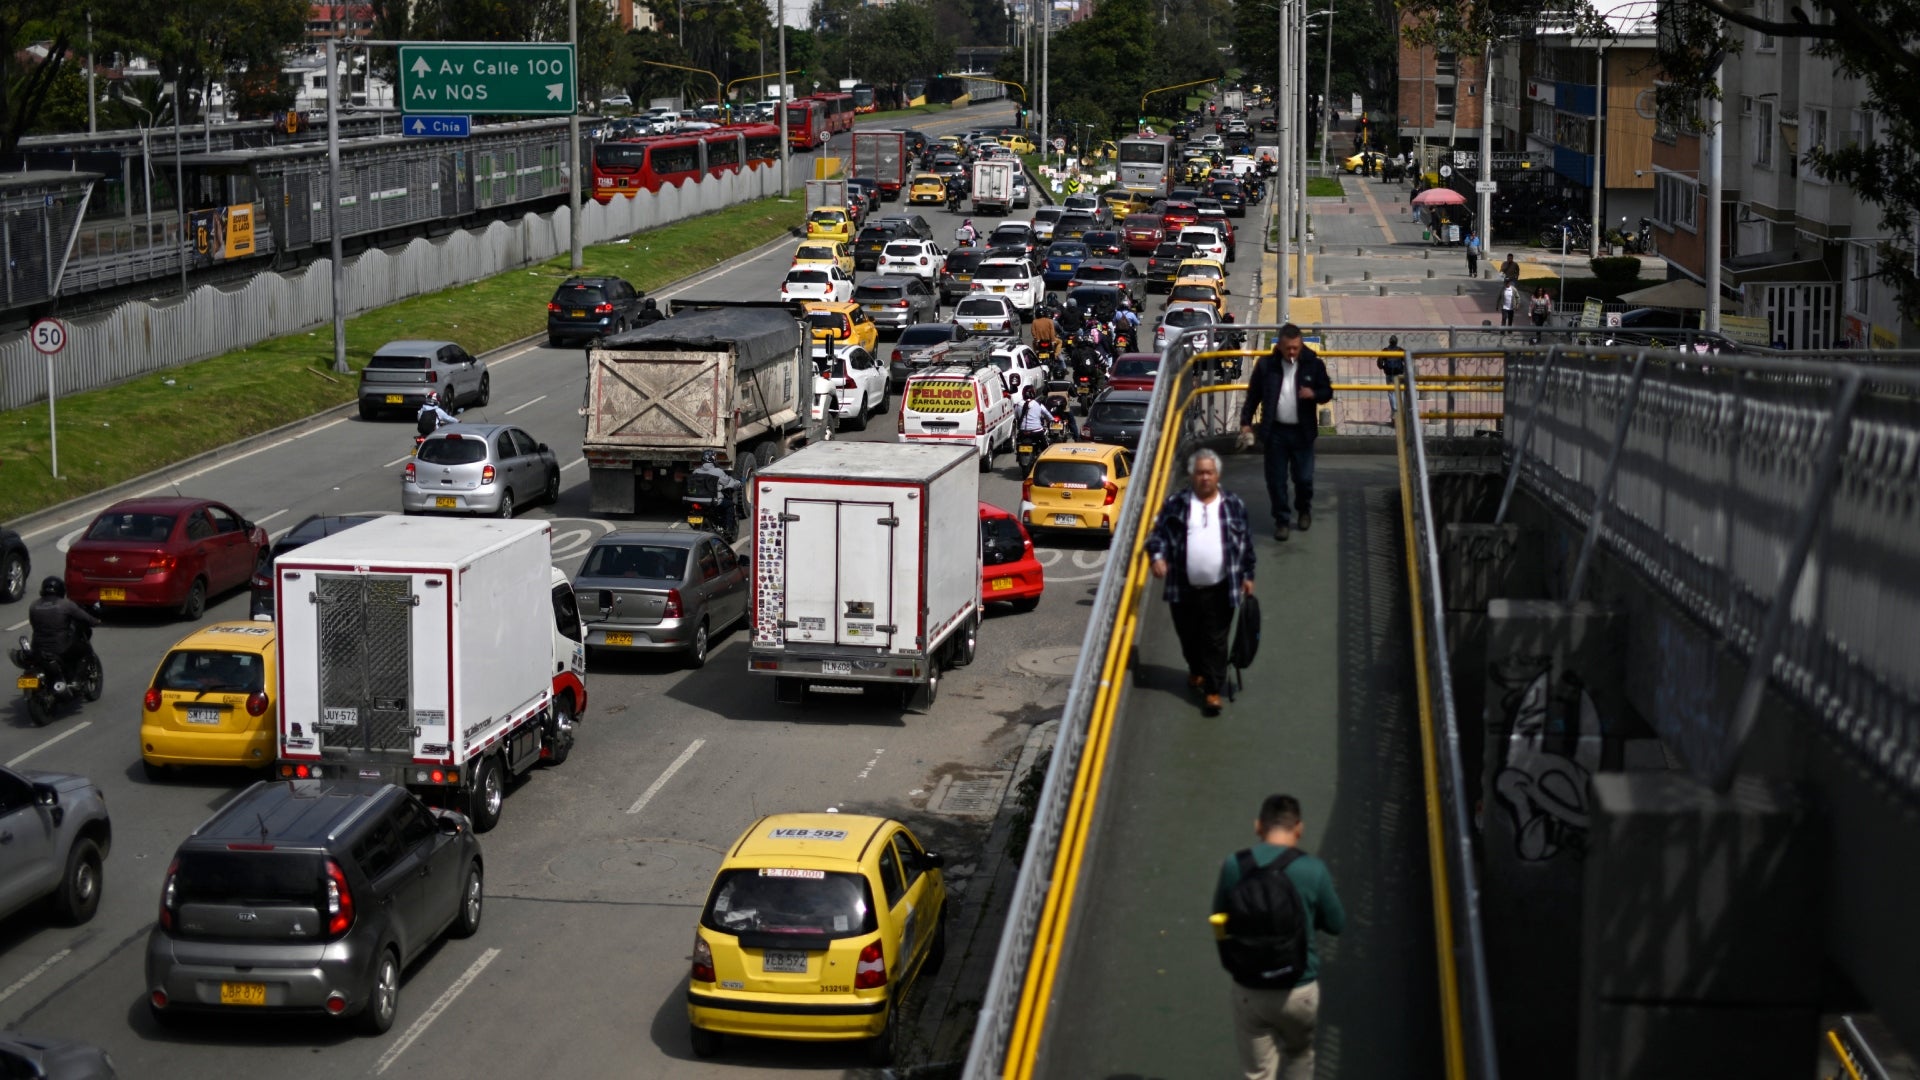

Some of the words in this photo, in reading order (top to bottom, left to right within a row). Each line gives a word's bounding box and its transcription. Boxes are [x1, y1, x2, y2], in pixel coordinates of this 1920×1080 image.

[440, 59, 464, 75] Av
[473, 59, 519, 75] Calle
[528, 59, 563, 75] 100
[412, 84, 437, 100] Av
[446, 84, 488, 100] NQS
[433, 121, 460, 132] Chía
[39, 328, 61, 345] 50
[912, 389, 973, 399] PELIGRO
